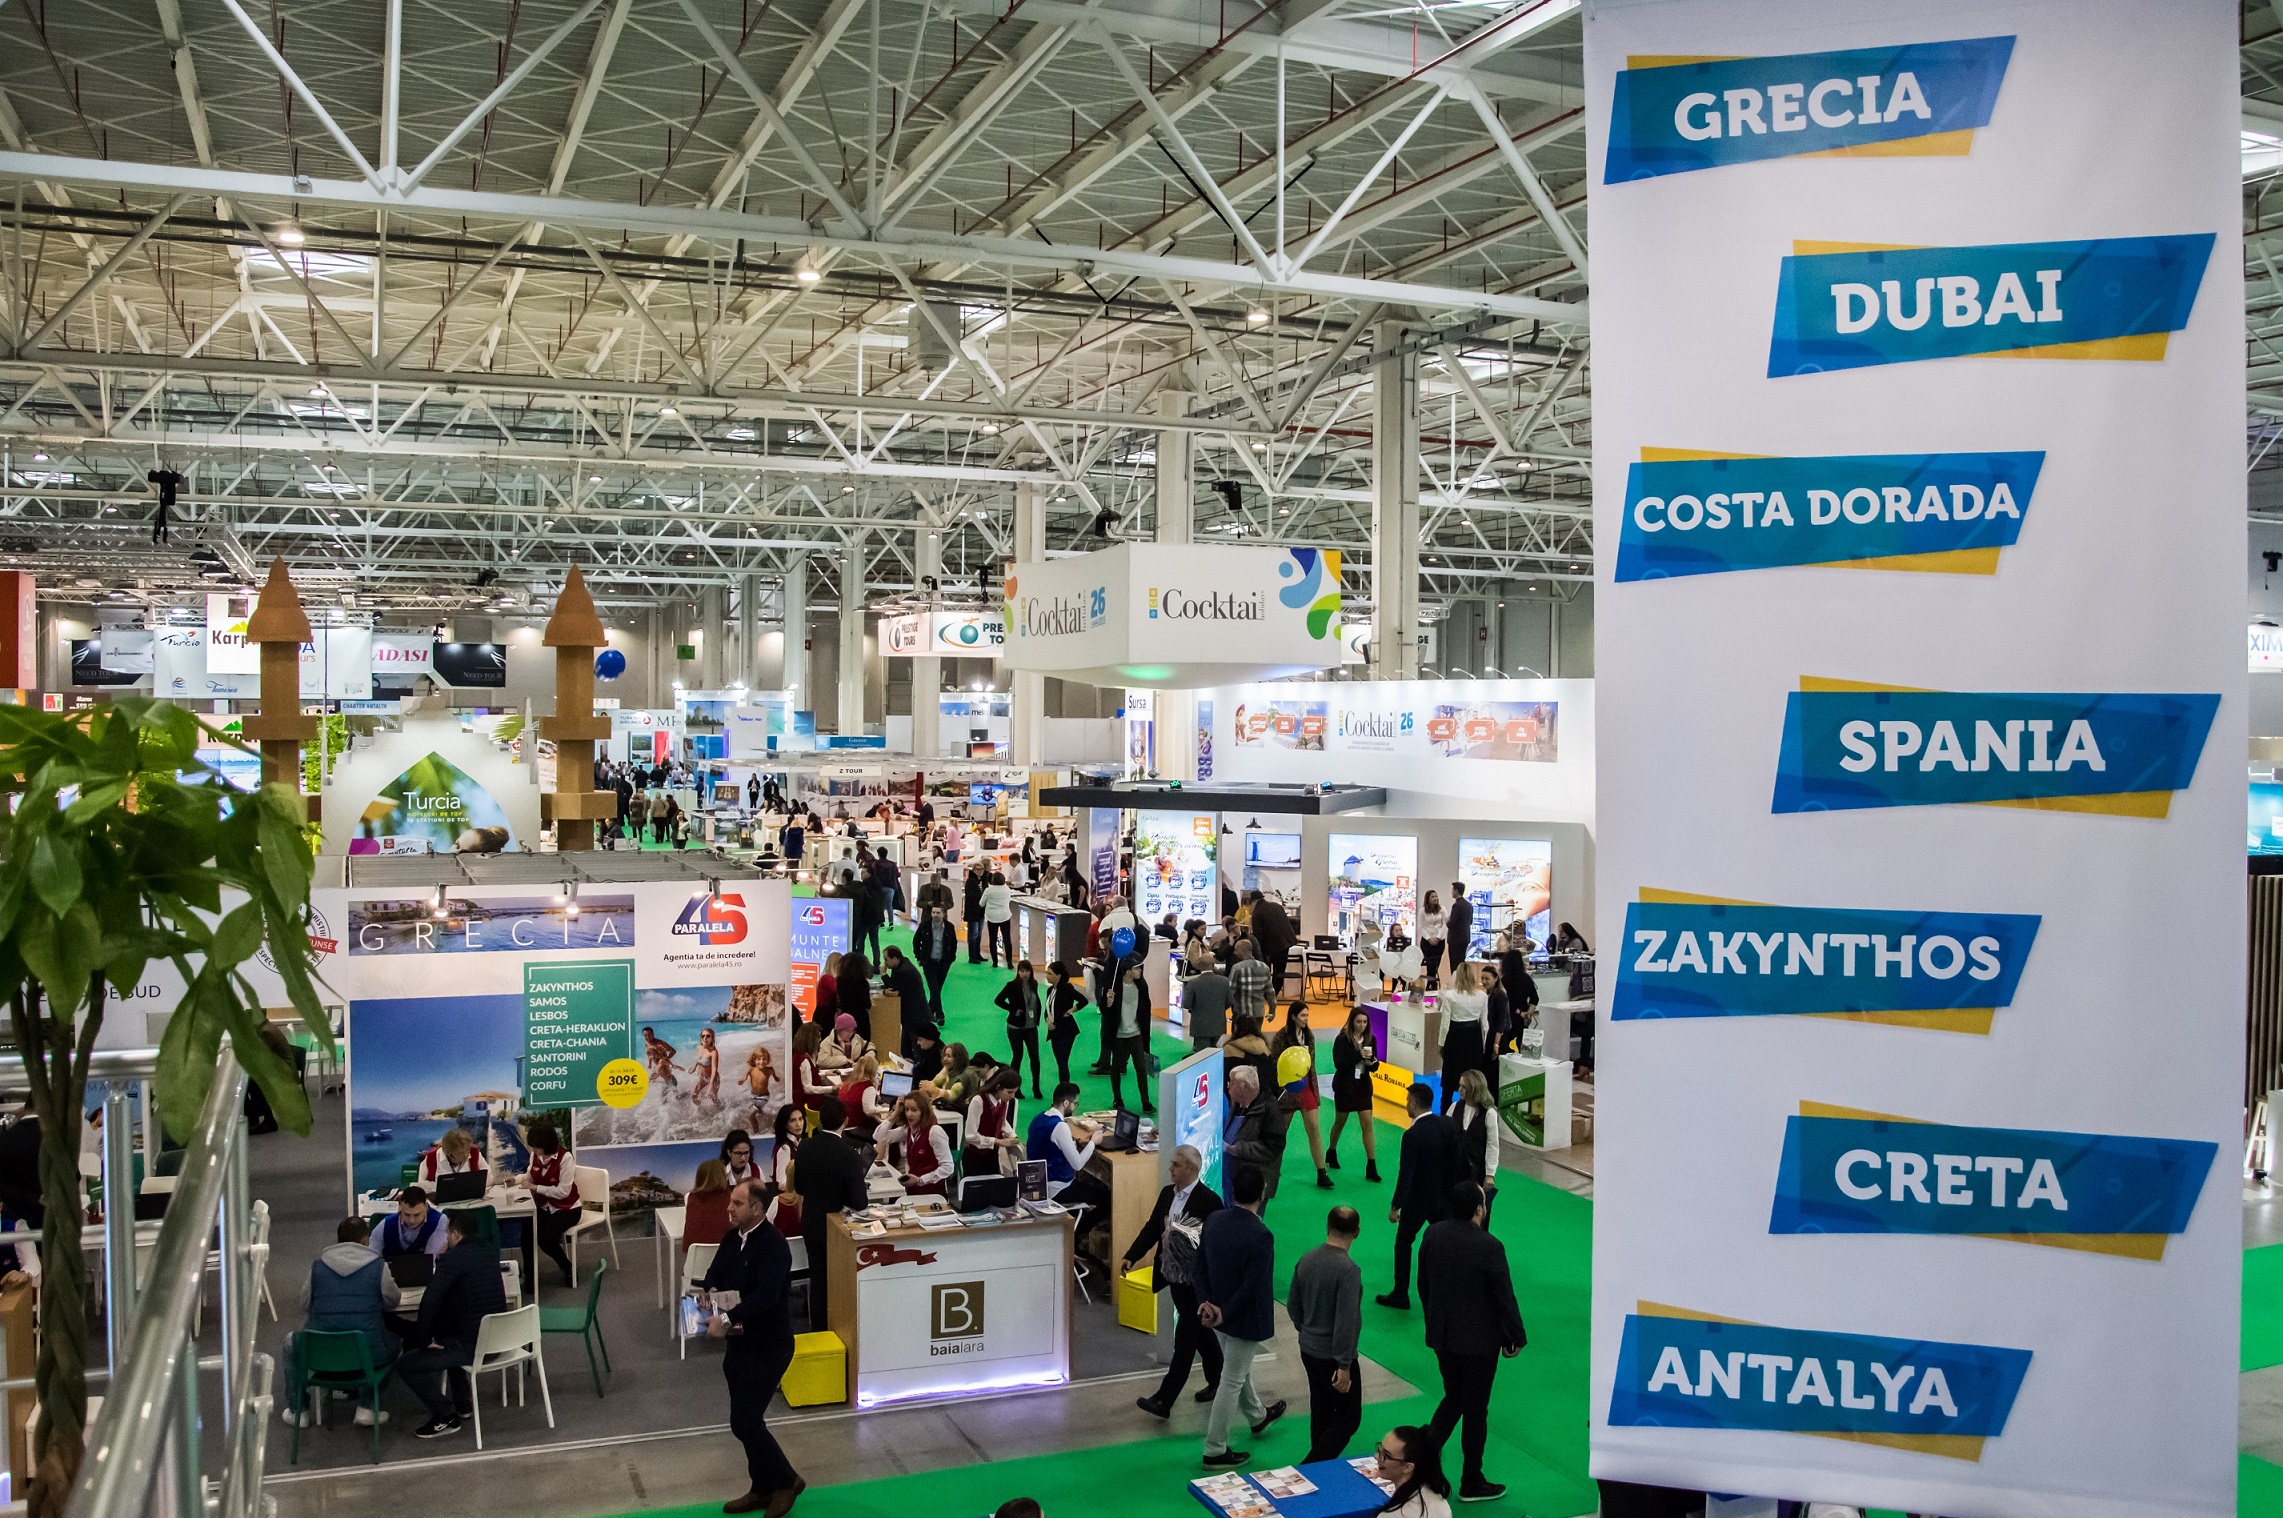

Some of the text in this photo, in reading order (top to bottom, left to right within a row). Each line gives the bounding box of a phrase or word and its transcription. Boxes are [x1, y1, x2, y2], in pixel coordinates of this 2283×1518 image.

[1673, 71, 1932, 142] GRECIA
[1830, 269, 2063, 334] DUBAI
[1633, 482, 2020, 533] COSTA DORADA
[1090, 586, 1106, 619] 26
[983, 622, 1003, 633] PRE
[904, 634, 915, 646] TOURS
[1400, 711, 1414, 731] 26
[1839, 719, 2106, 773] SPANIA
[402, 791, 461, 810] Turcia
[359, 917, 621, 951] GRECIA
[674, 922, 734, 934] PARALELA
[663, 953, 694, 962] Agentia
[717, 951, 756, 959] incredere!
[791, 948, 837, 960] ALNE
[1633, 930, 2001, 981] ZAKYNTHOS
[677, 961, 742, 970] www.paralela45.ro
[529, 981, 594, 993] ZAKYNTHOS
[529, 996, 567, 1007] SAMOS
[530, 1011, 568, 1021] LESBOS
[530, 1022, 626, 1035] CRETA-HERAKLION
[530, 1037, 607, 1049] CRETA-CHANIA
[530, 1052, 587, 1063] SANTORINI
[530, 1066, 568, 1077] RODOS
[530, 1081, 566, 1091] CORFU
[608, 1074, 638, 1086] 309€
[1834, 1149, 2068, 1211] CRETA
[930, 1342, 985, 1357] baialara
[1647, 1345, 1959, 1418] ANTALYA
